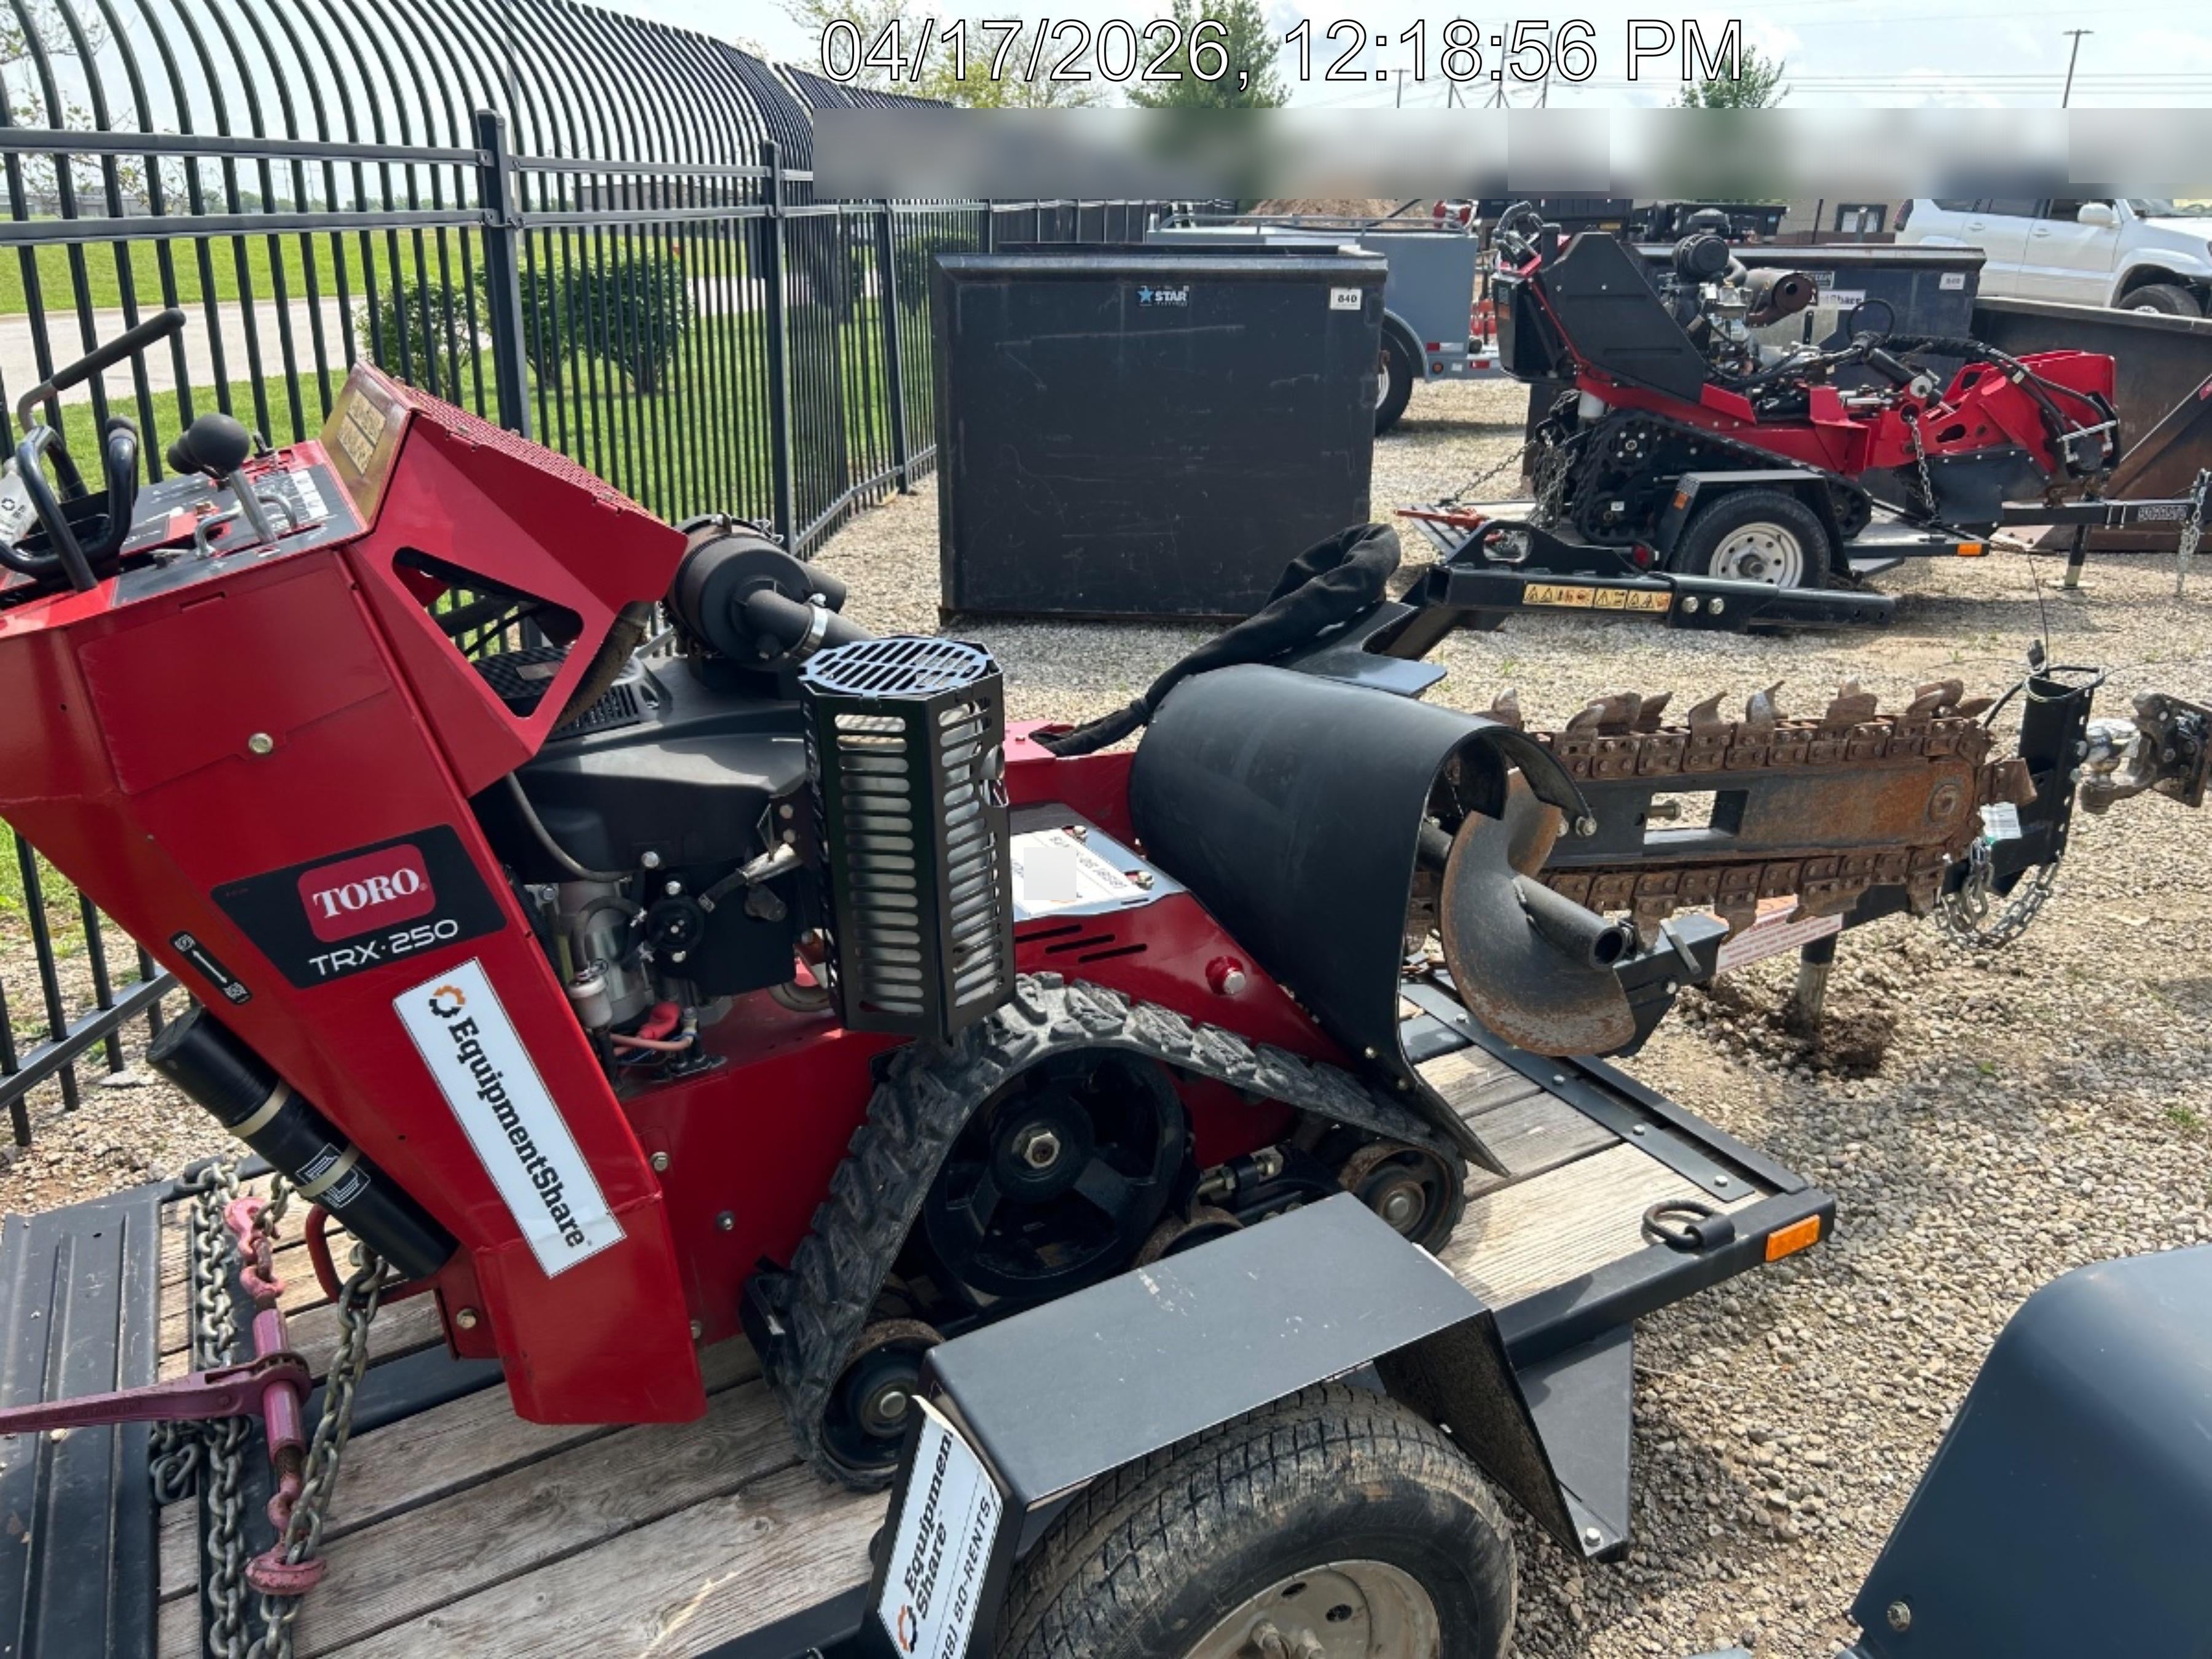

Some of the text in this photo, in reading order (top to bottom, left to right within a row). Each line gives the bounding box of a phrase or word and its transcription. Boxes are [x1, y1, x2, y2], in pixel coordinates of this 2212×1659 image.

[1155, 290, 1186, 302] STAR
[312, 868, 420, 919] TORO
[447, 1016, 586, 1247] EquipmentShare
[916, 1521, 947, 1620] Share
[953, 1496, 991, 1623] 80-RENTS
